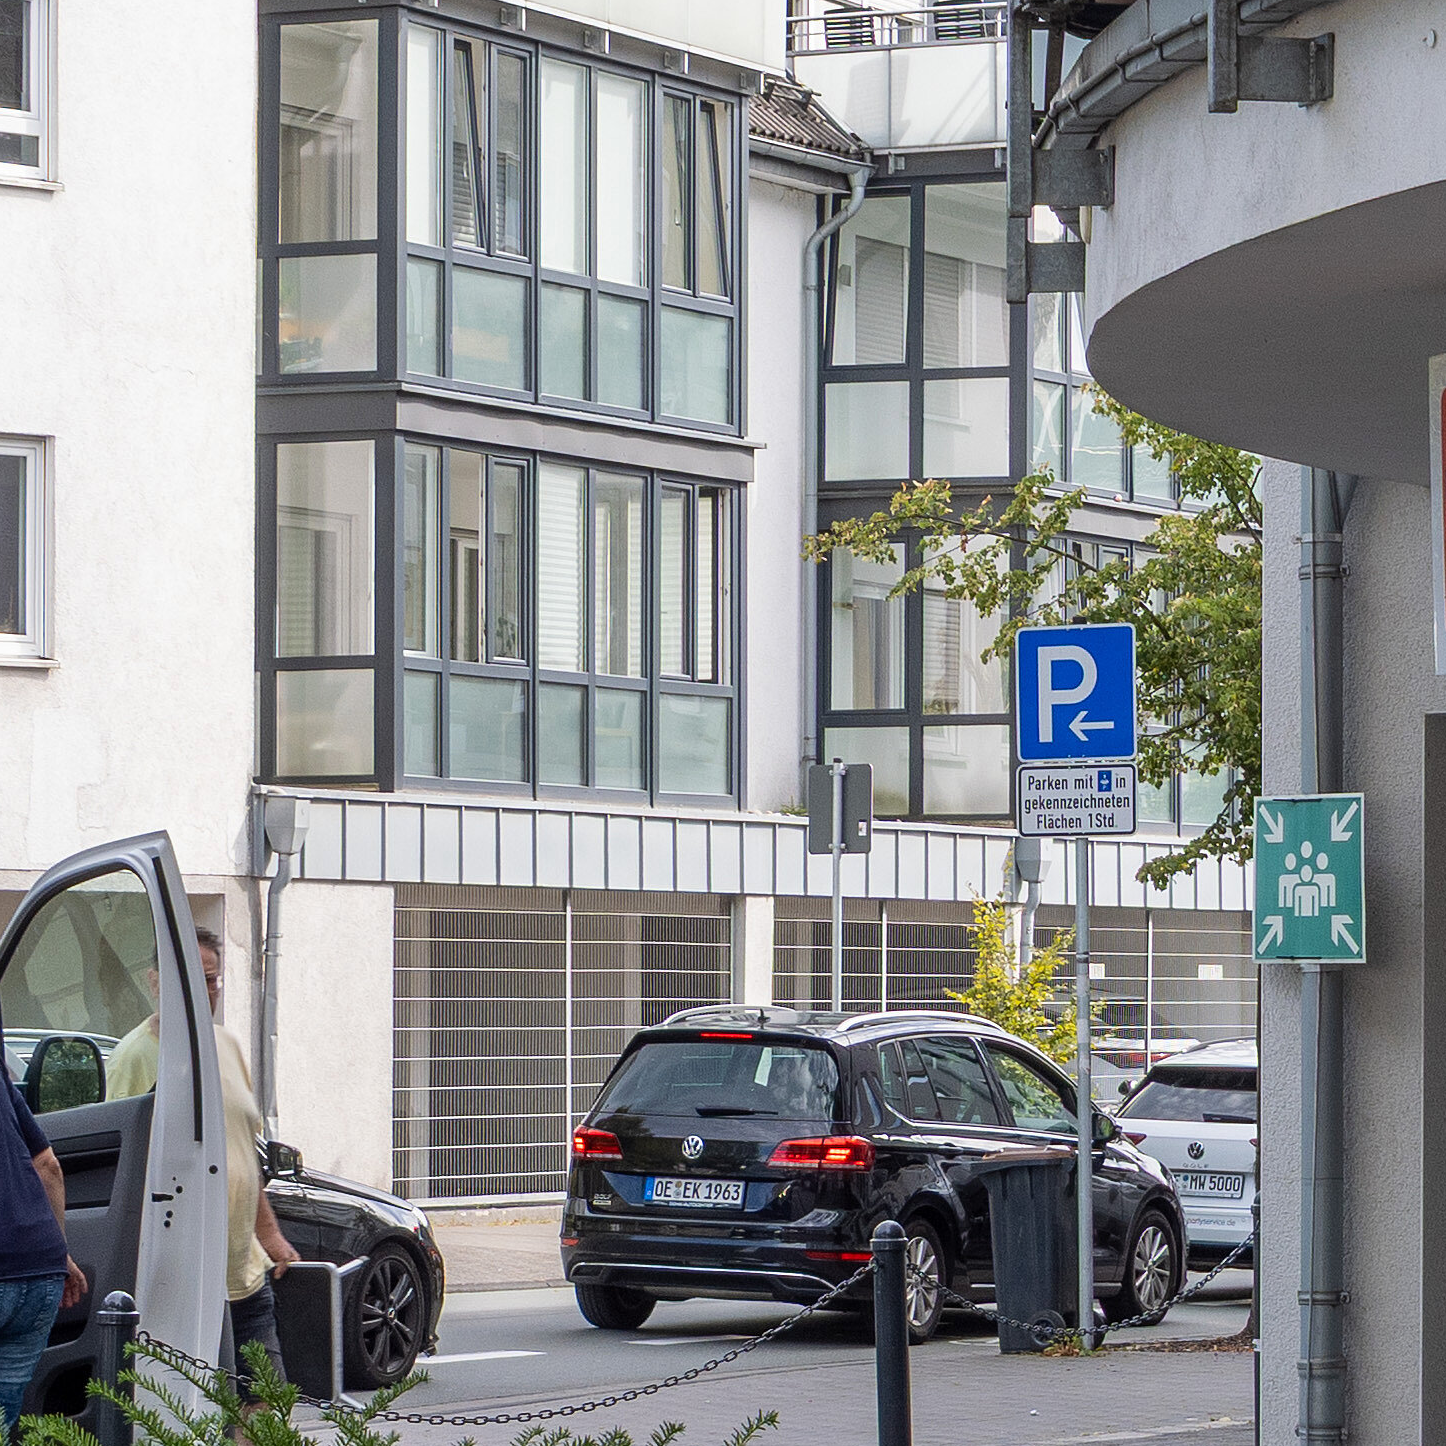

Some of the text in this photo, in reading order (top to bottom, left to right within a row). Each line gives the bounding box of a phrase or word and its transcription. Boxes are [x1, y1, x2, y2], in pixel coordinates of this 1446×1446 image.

[1037, 646, 1097, 743] P
[1027, 773, 1126, 791] Parken mit in
[1024, 794, 1130, 814] gekennzeichneten
[1036, 813, 1082, 829] Flächen
[683, 1181, 702, 1199] EK
[704, 1183, 741, 1201] 1963
[1189, 1175, 1205, 1191] MW
[1209, 1176, 1240, 1192] 5000
